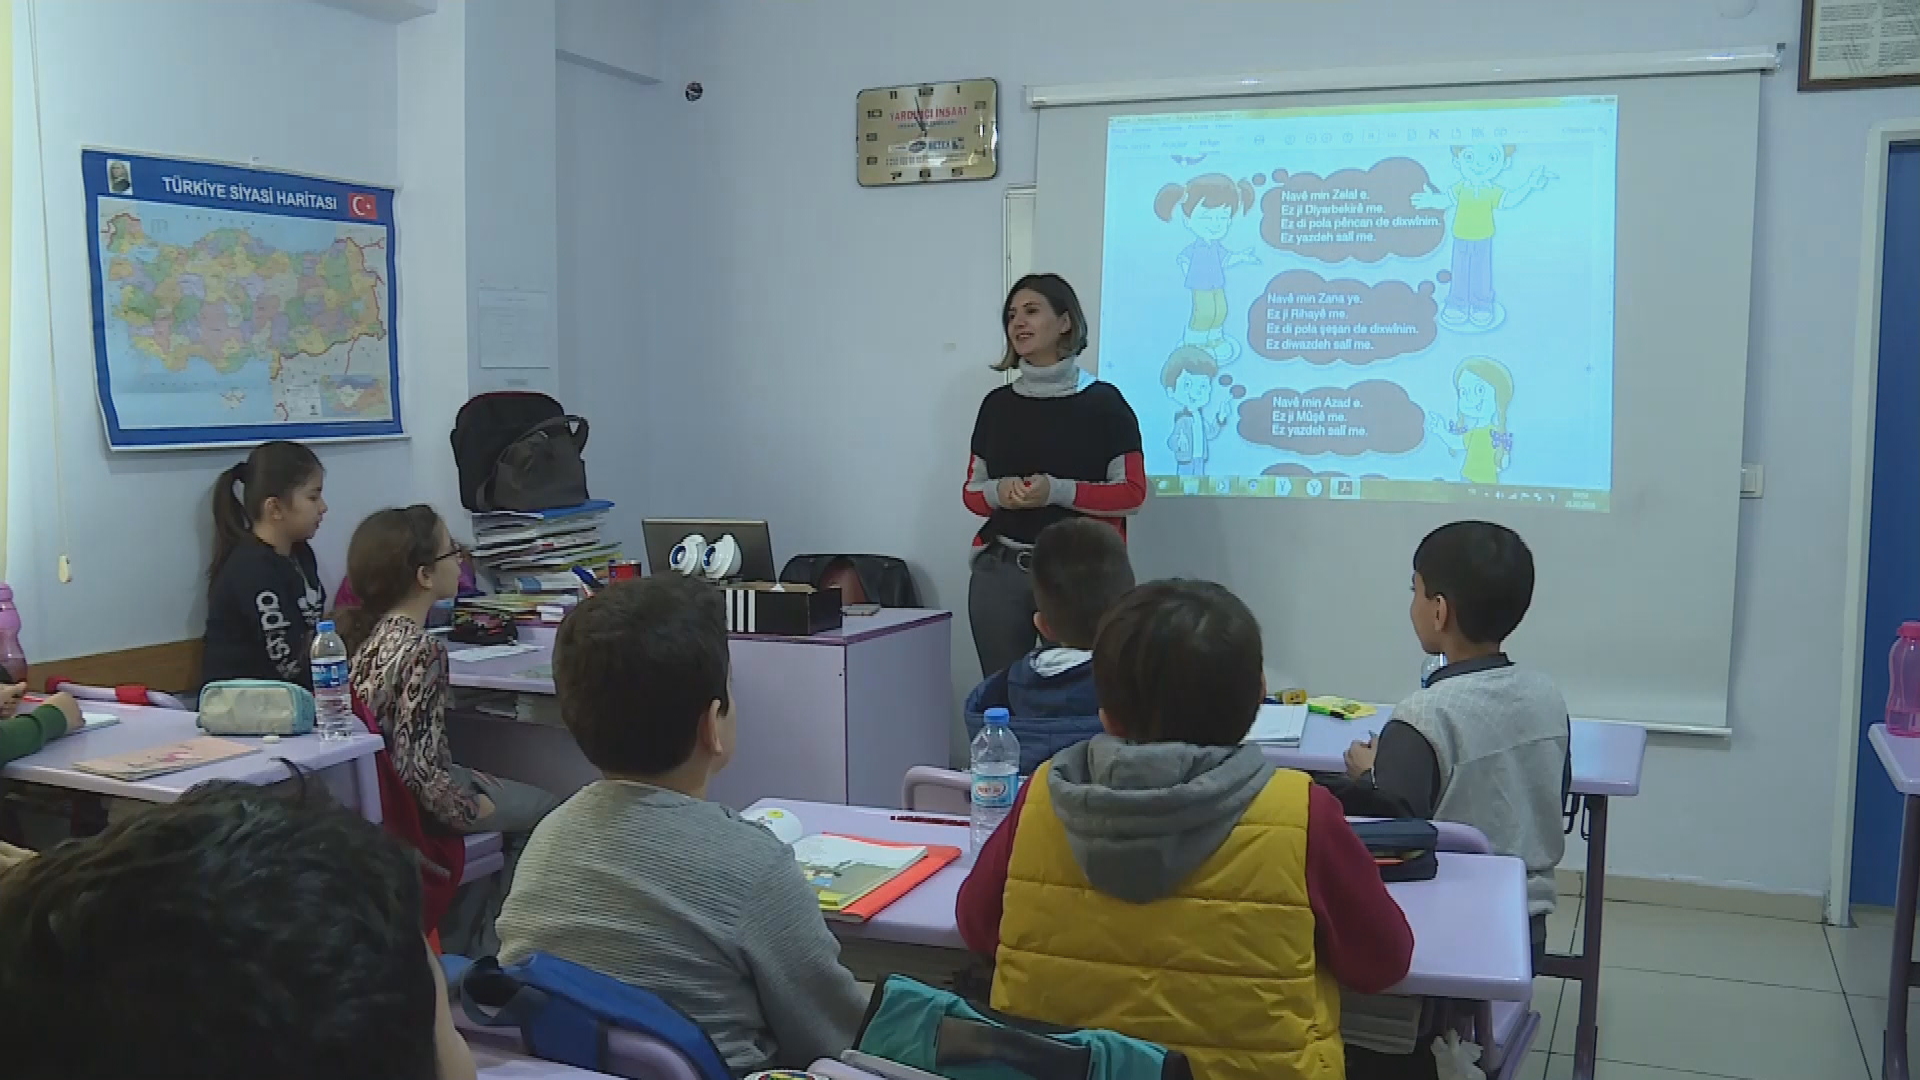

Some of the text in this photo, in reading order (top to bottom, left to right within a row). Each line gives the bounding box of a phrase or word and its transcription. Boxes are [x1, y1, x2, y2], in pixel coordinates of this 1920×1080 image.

[162, 175, 337, 210] TÜRKİYE SİYASİ HARİTASI
[1281, 190, 1308, 202] Navê
[1310, 191, 1330, 200] min
[1332, 188, 1358, 200] Zelal
[1281, 203, 1386, 217] Ez ji Diyarbekirê me.
[1281, 219, 1294, 230] Ez
[1296, 218, 1307, 228] di
[1309, 218, 1332, 230] pola
[1334, 217, 1374, 230] pêncan
[1376, 216, 1390, 227] de
[1280, 233, 1294, 244] Ez
[1296, 232, 1334, 245] yazdeh
[1356, 232, 1376, 242] me.
[1267, 292, 1364, 306] Navê min Zana ye.
[1266, 308, 1348, 321] Ez ji Rihayê me.
[1266, 323, 1280, 334] Ez
[1282, 323, 1293, 334] di
[1294, 323, 1318, 336] pola
[1353, 322, 1367, 334] de
[1266, 339, 1280, 350] Ez
[1282, 338, 1331, 350] diwazdeh
[1354, 340, 1374, 350] me.
[1272, 396, 1300, 408] Navê
[1302, 396, 1322, 408] min
[1324, 396, 1350, 408] Azad
[1272, 411, 1286, 422] Ez
[1288, 410, 1294, 423] ji
[1327, 412, 1348, 422] me.
[1272, 424, 1286, 436] Ez
[1288, 424, 1326, 437] yazdeh
[1348, 426, 1368, 436] me.
